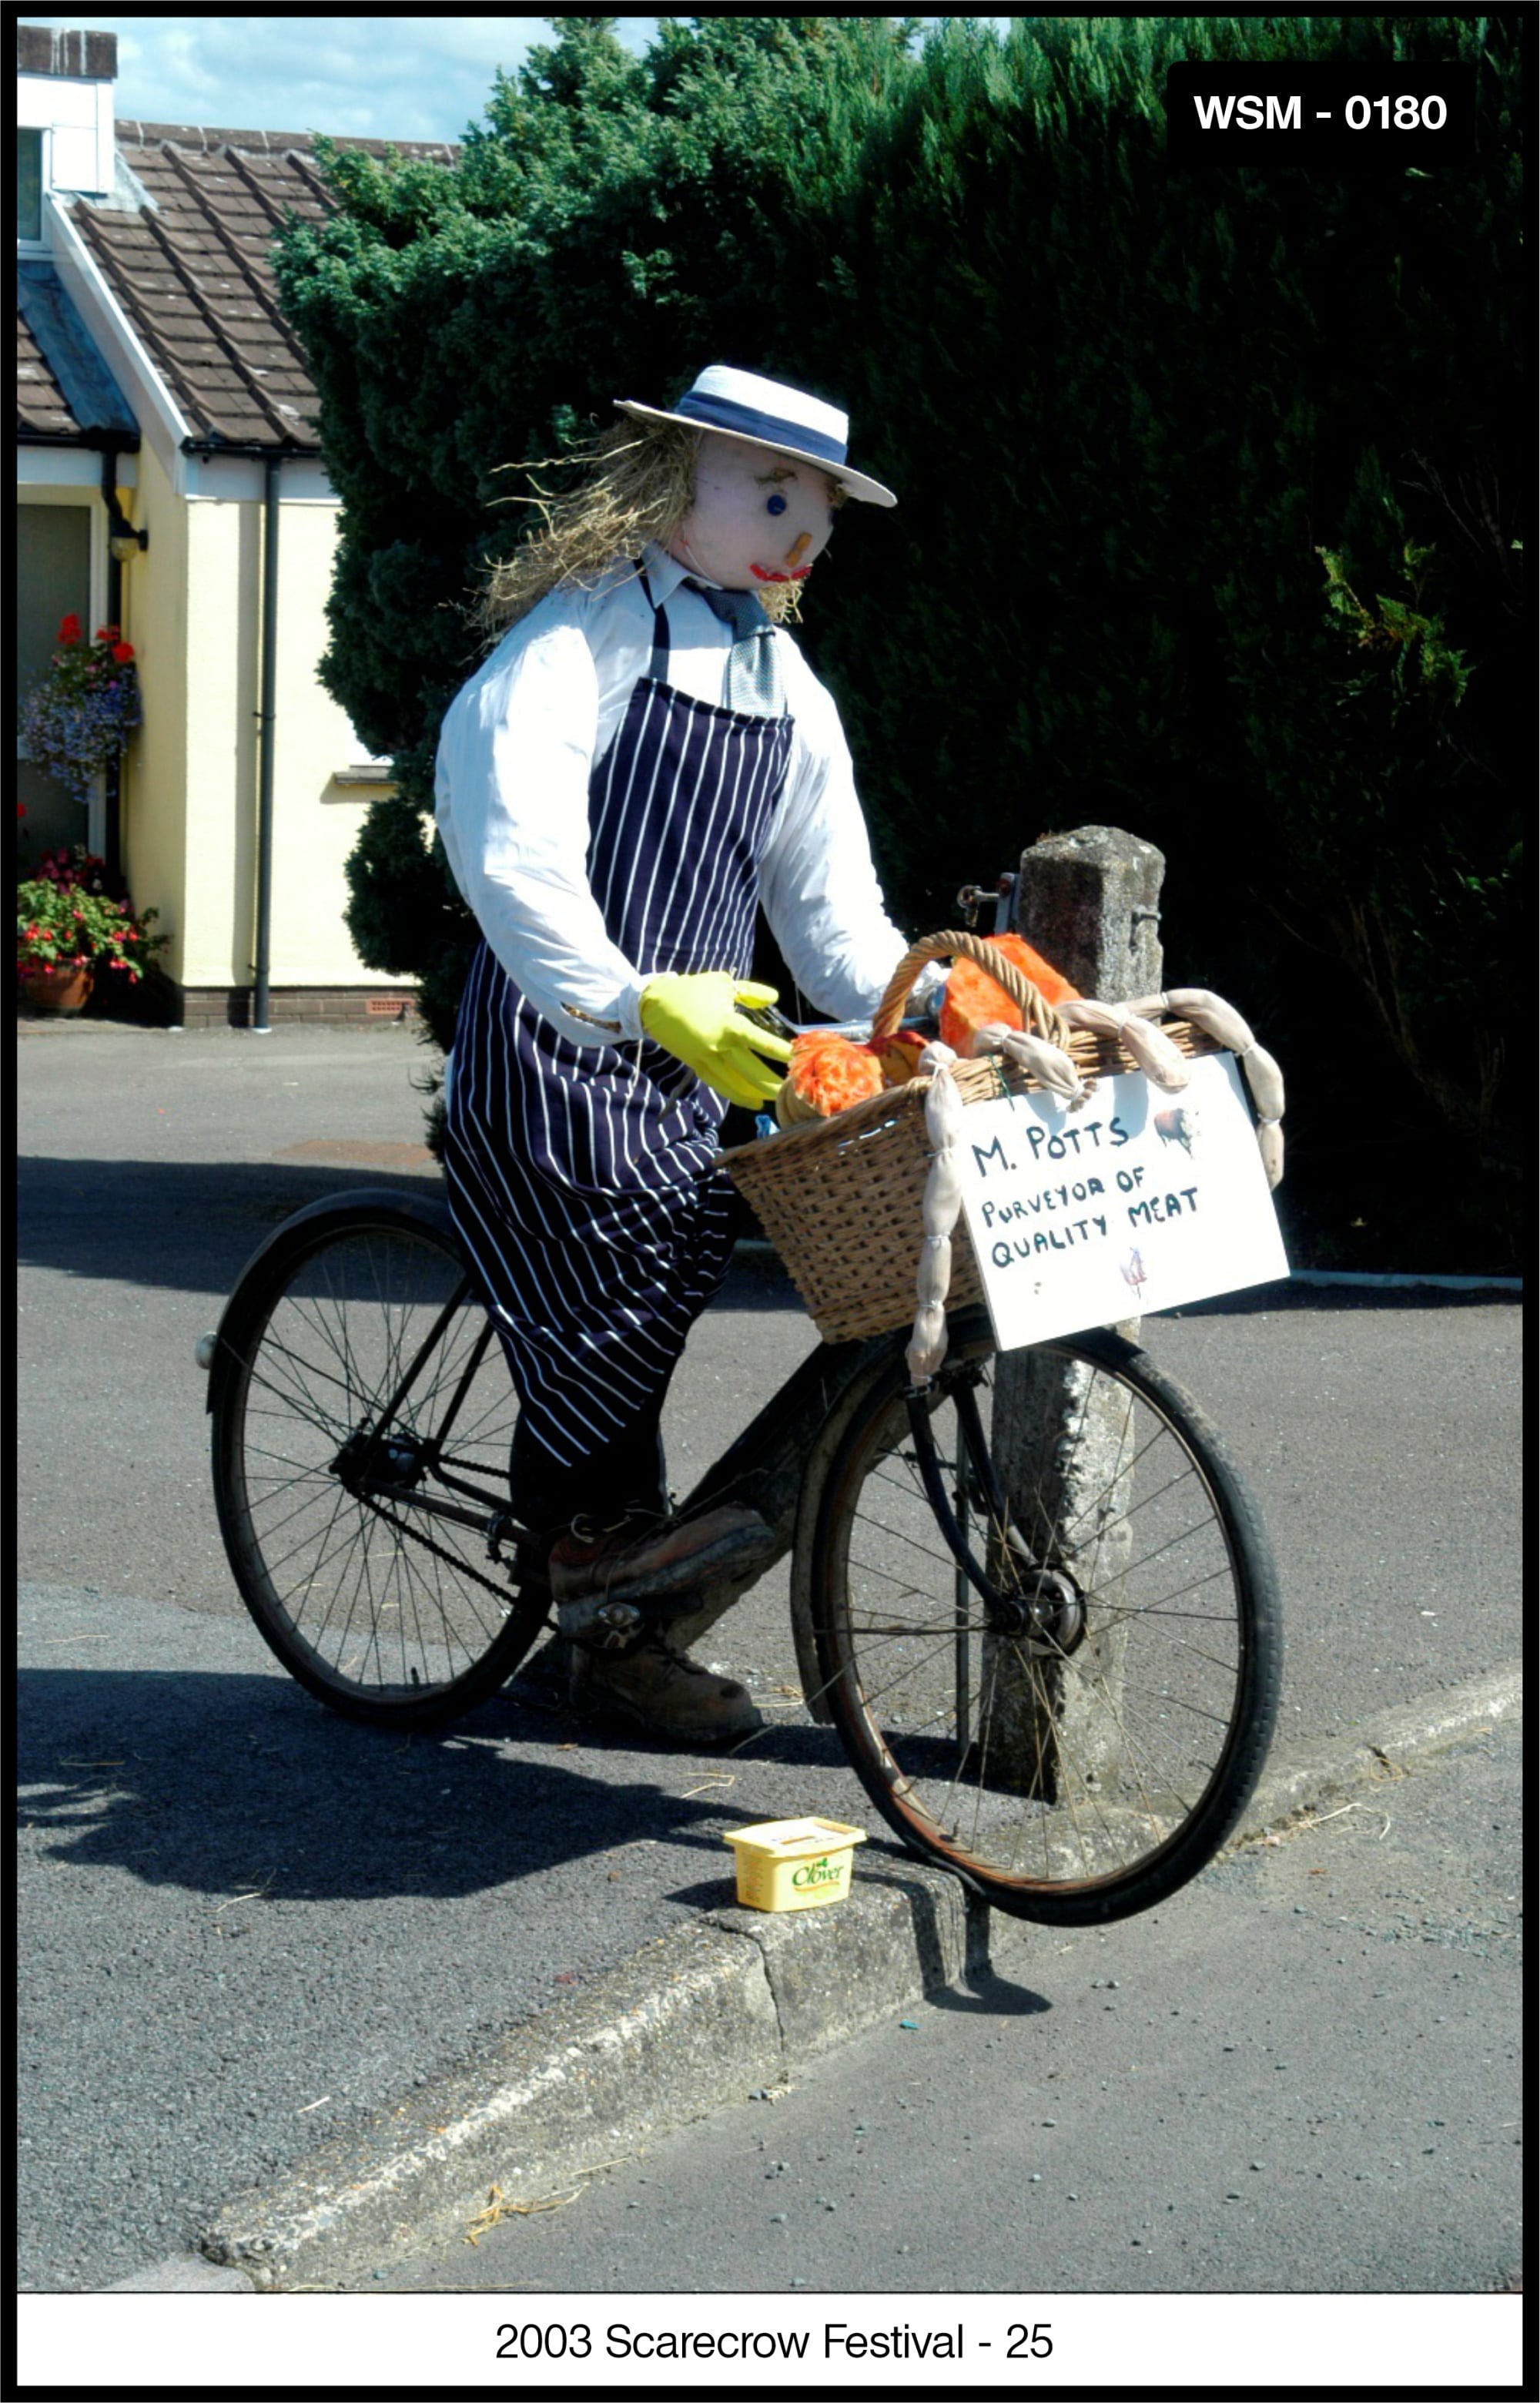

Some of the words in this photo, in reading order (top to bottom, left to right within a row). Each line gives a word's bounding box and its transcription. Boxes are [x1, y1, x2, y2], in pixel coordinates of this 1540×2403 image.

[971, 1135, 1017, 1178] M.
[1026, 1116, 1130, 1161] POTTS
[982, 1177, 1105, 1228] PURVEYOR
[1116, 1166, 1145, 1194] OF
[991, 1215, 1107, 1269] QUALITY
[1127, 1187, 1199, 1228] MEAT
[792, 1862, 844, 1887] Clover
